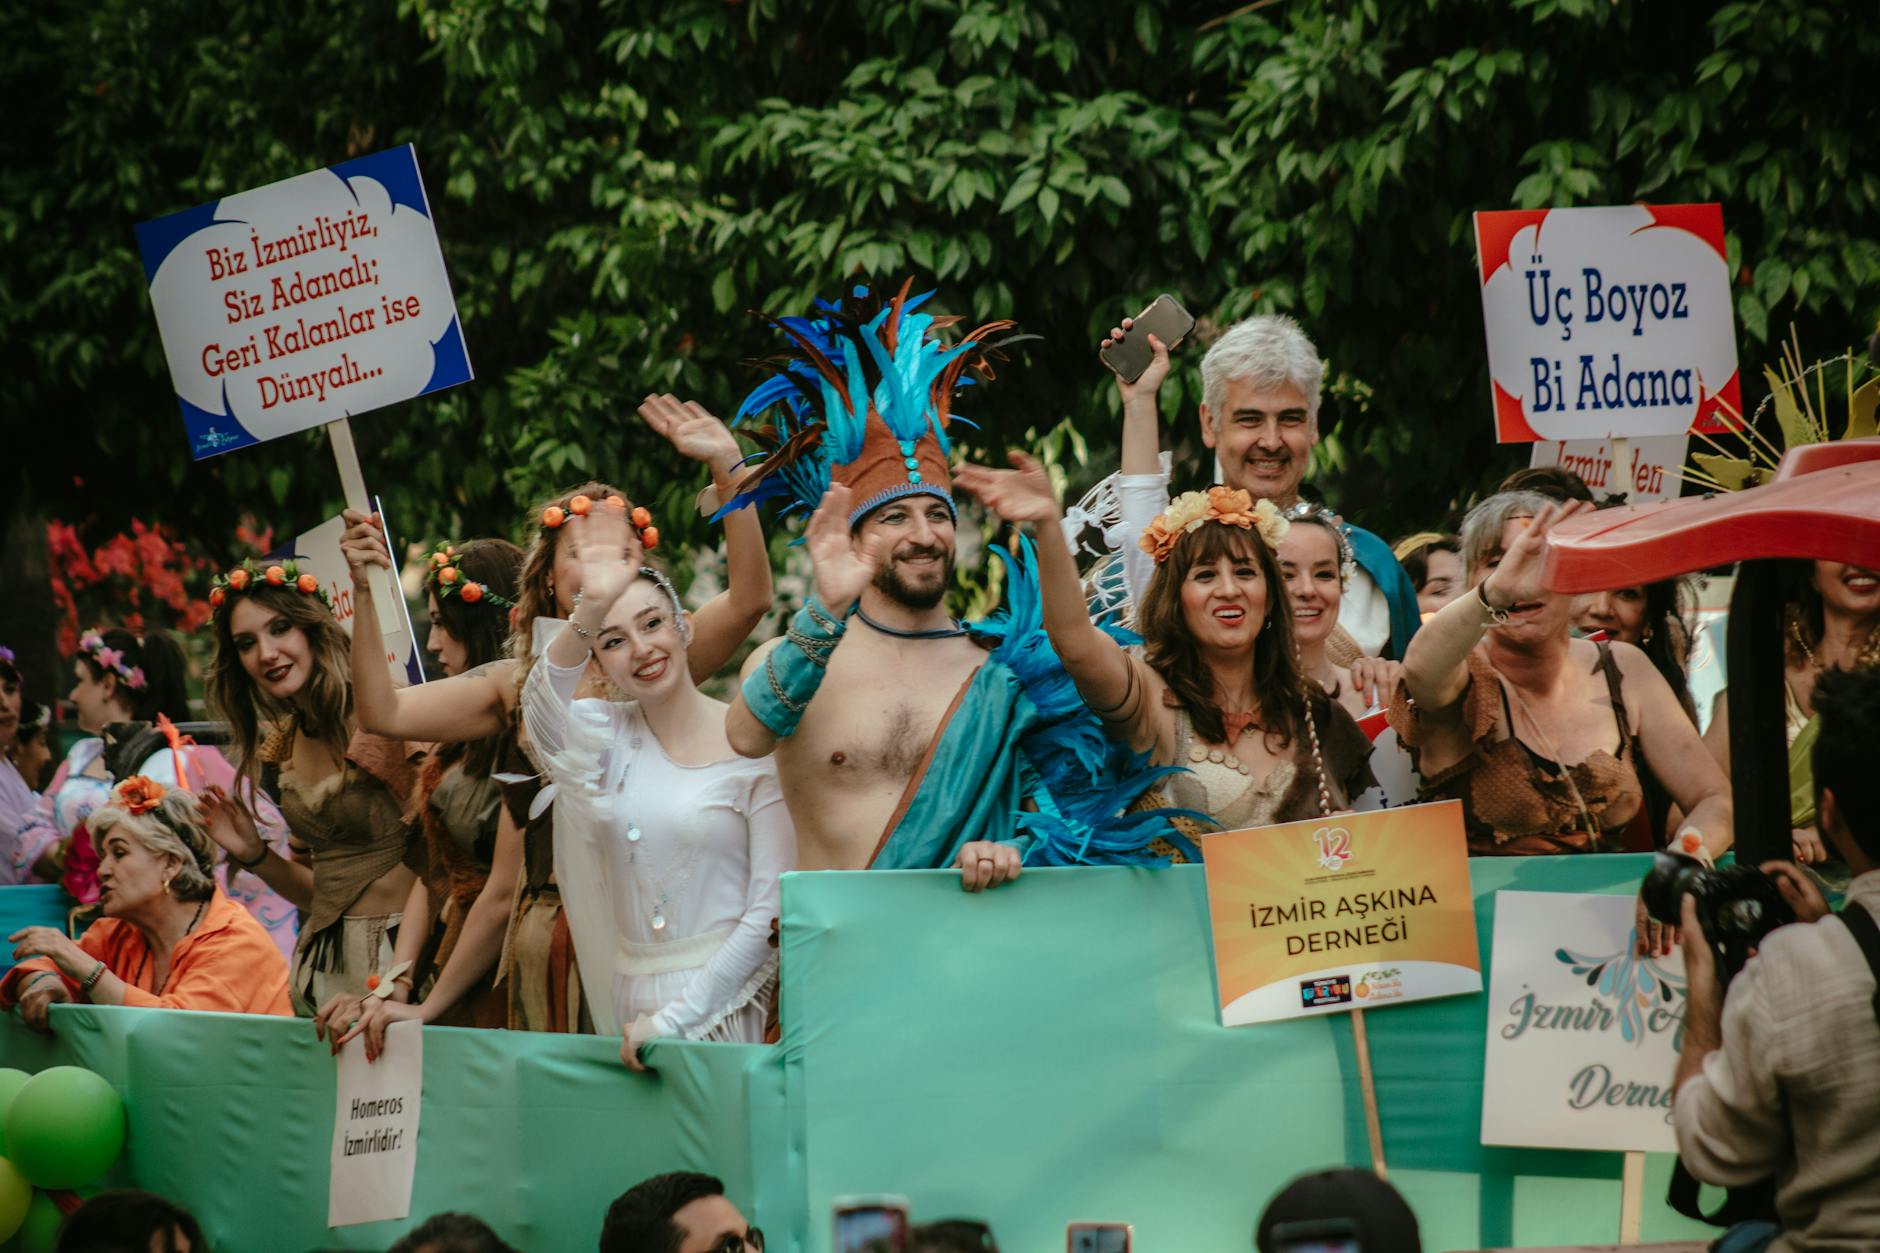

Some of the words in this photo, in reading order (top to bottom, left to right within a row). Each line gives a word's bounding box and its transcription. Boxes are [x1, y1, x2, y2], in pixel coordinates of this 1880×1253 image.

[206, 247, 248, 281] Biz
[250, 209, 378, 268] İzmirliyiz,
[224, 289, 264, 324] Siz
[271, 254, 379, 311] Adanalı;
[1525, 254, 1573, 341] Üç
[1582, 268, 1688, 336] Boyoz
[201, 335, 261, 377] Geri
[263, 306, 376, 360] Kalanlar
[381, 295, 421, 325] ise
[256, 353, 383, 410] Dünyalı...
[1530, 357, 1566, 412] Bi
[1576, 353, 1694, 410] Adana
[1313, 827, 1353, 861] 12
[1250, 896, 1326, 928] İZMİR
[1335, 885, 1438, 919] AŞKINA
[1286, 915, 1408, 956] DERNEĞİ
[351, 1097, 404, 1120] Homeros
[344, 1127, 404, 1157] İzmirlidir!
